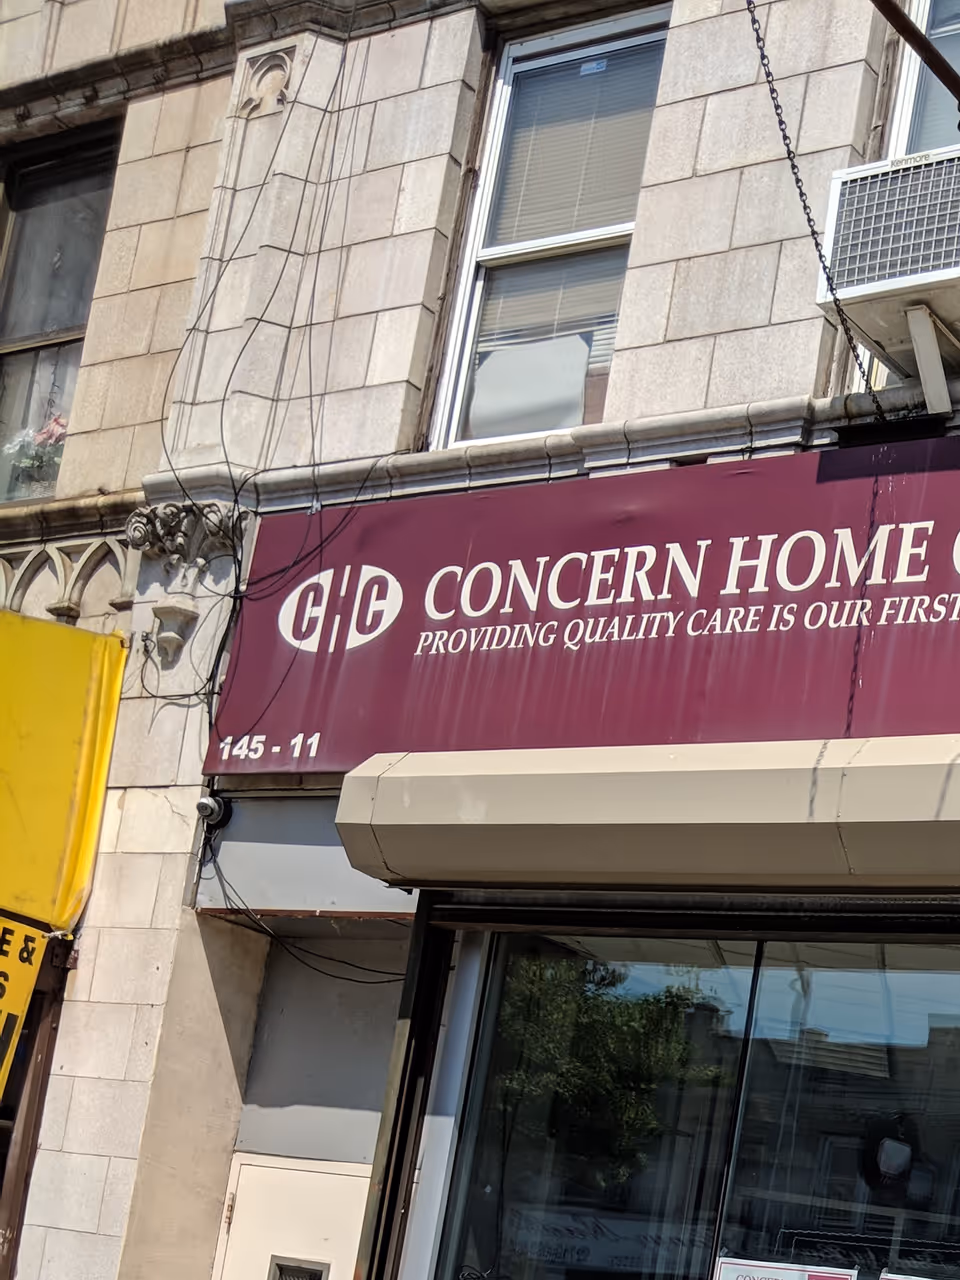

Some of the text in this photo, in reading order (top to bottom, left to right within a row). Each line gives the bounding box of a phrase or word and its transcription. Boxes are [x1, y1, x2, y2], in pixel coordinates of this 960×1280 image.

[425, 539, 711, 620] CONCERN
[720, 520, 934, 597] HOME
[414, 621, 557, 656] PROVIDING
[563, 610, 683, 651] QUALITY
[686, 605, 761, 636] CARE
[767, 603, 797, 632] IS
[803, 600, 872, 631] OUR
[219, 735, 266, 760] 145
[289, 732, 321, 759] 11
